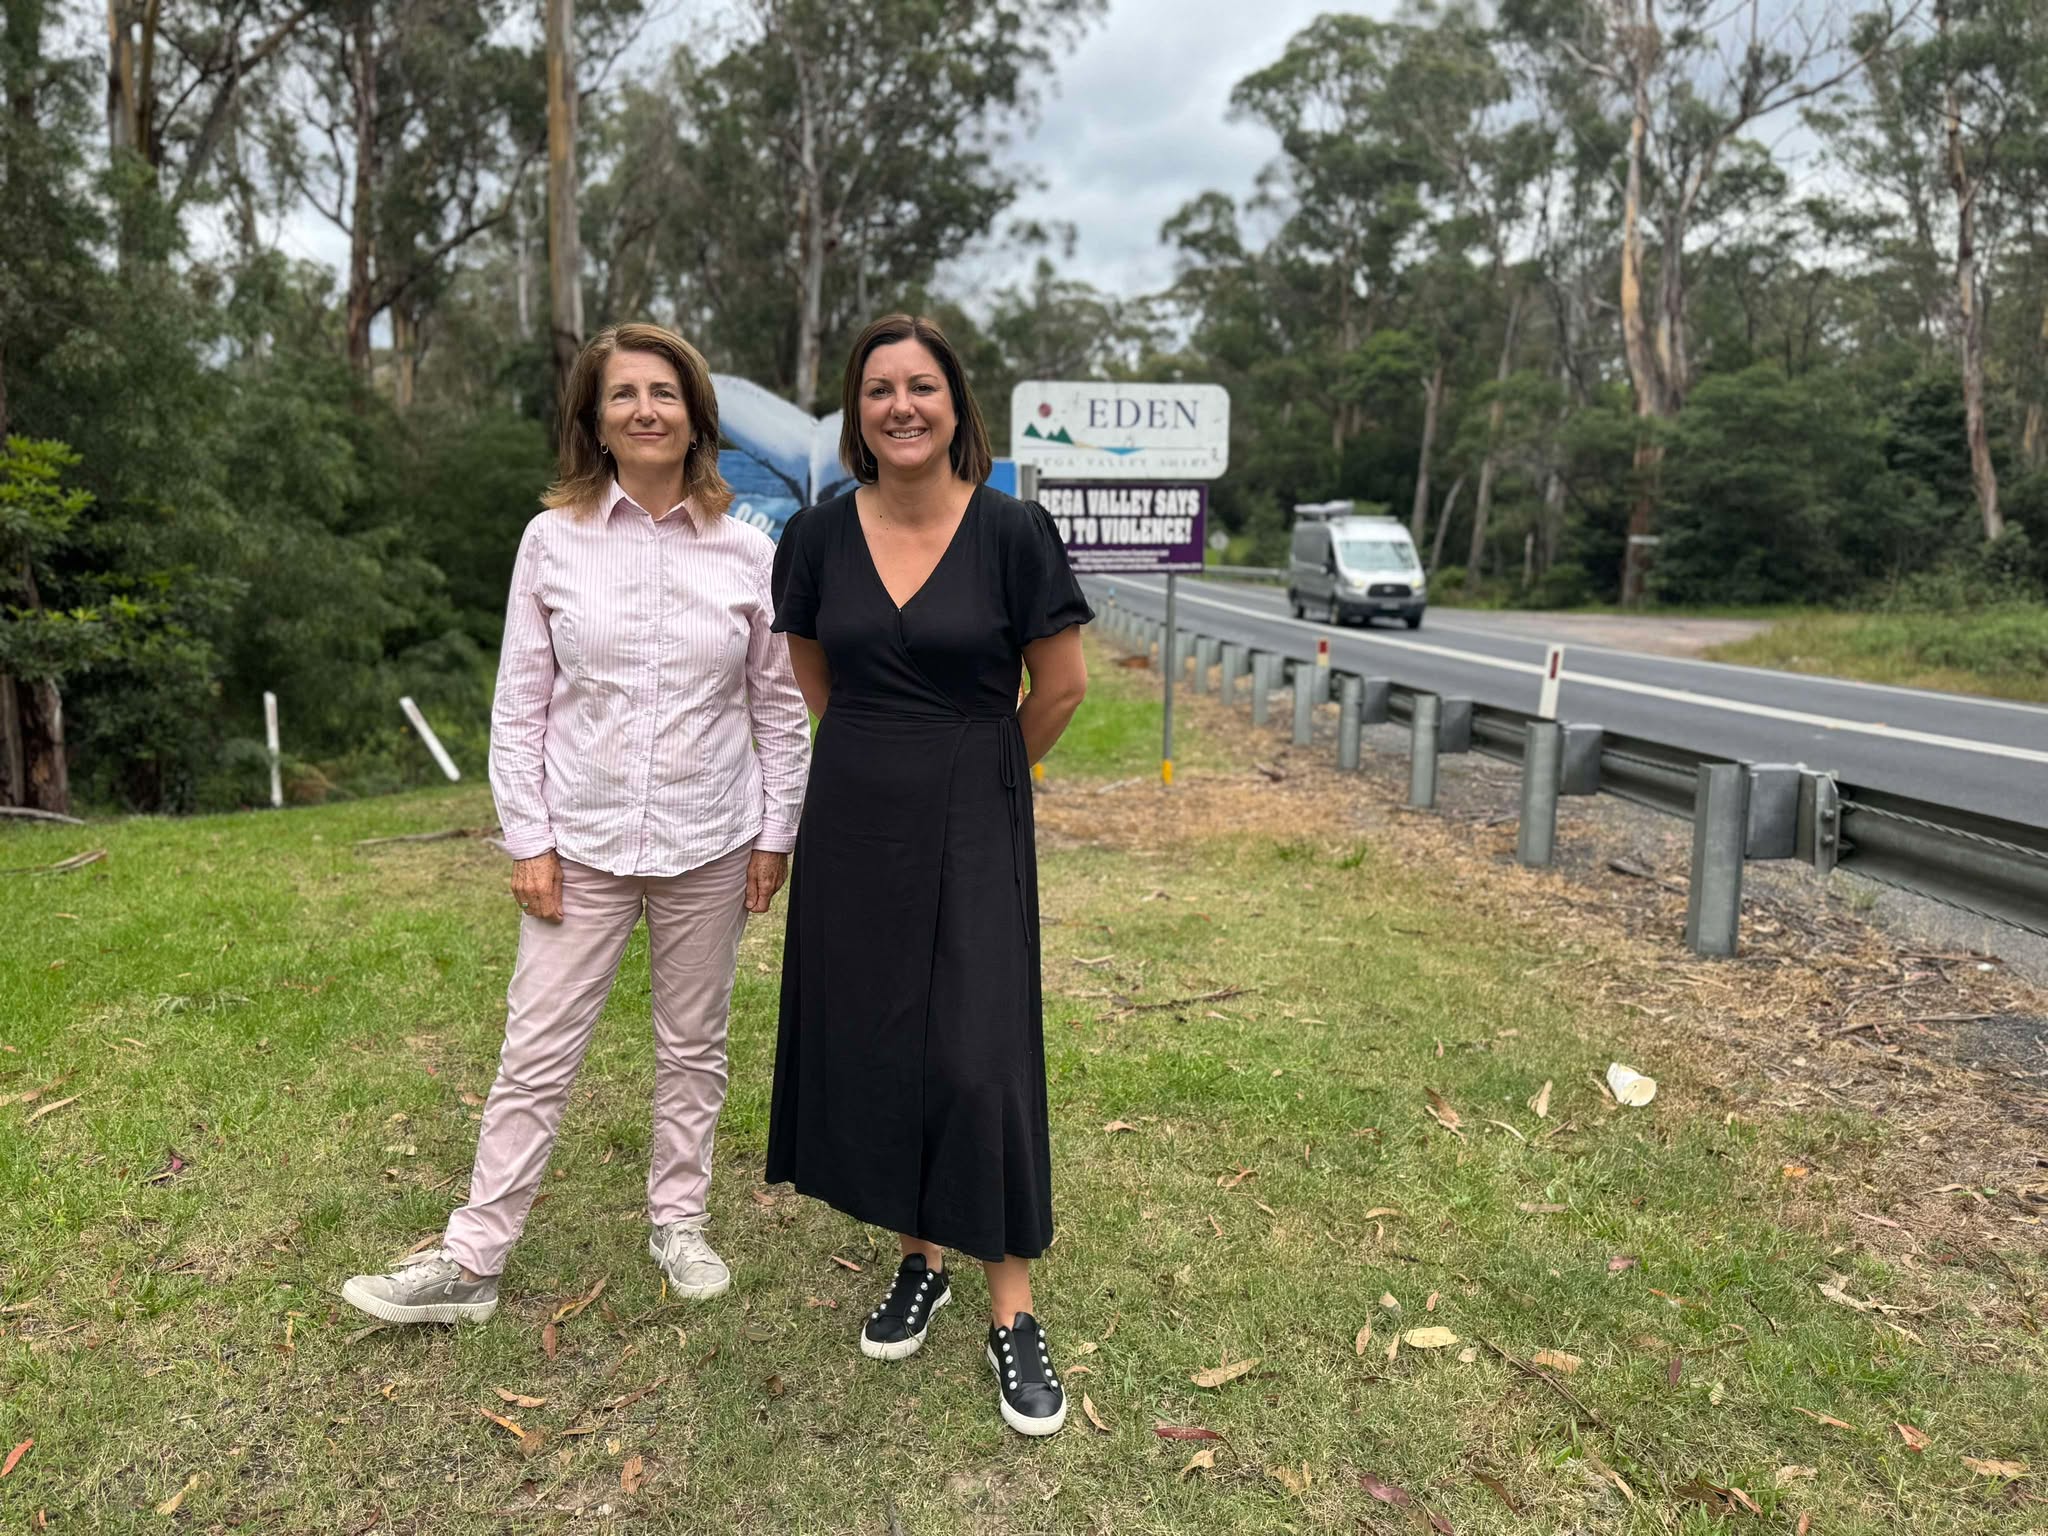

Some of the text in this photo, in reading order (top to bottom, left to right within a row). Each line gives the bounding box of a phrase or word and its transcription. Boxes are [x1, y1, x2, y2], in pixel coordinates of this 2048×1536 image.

[1087, 398, 1200, 430] EDEN
[1086, 489, 1153, 516] VALLEY
[1154, 489, 1200, 517] SAYS
[1072, 517, 1098, 545] TO
[1099, 517, 1193, 545] VIOLENCE!
